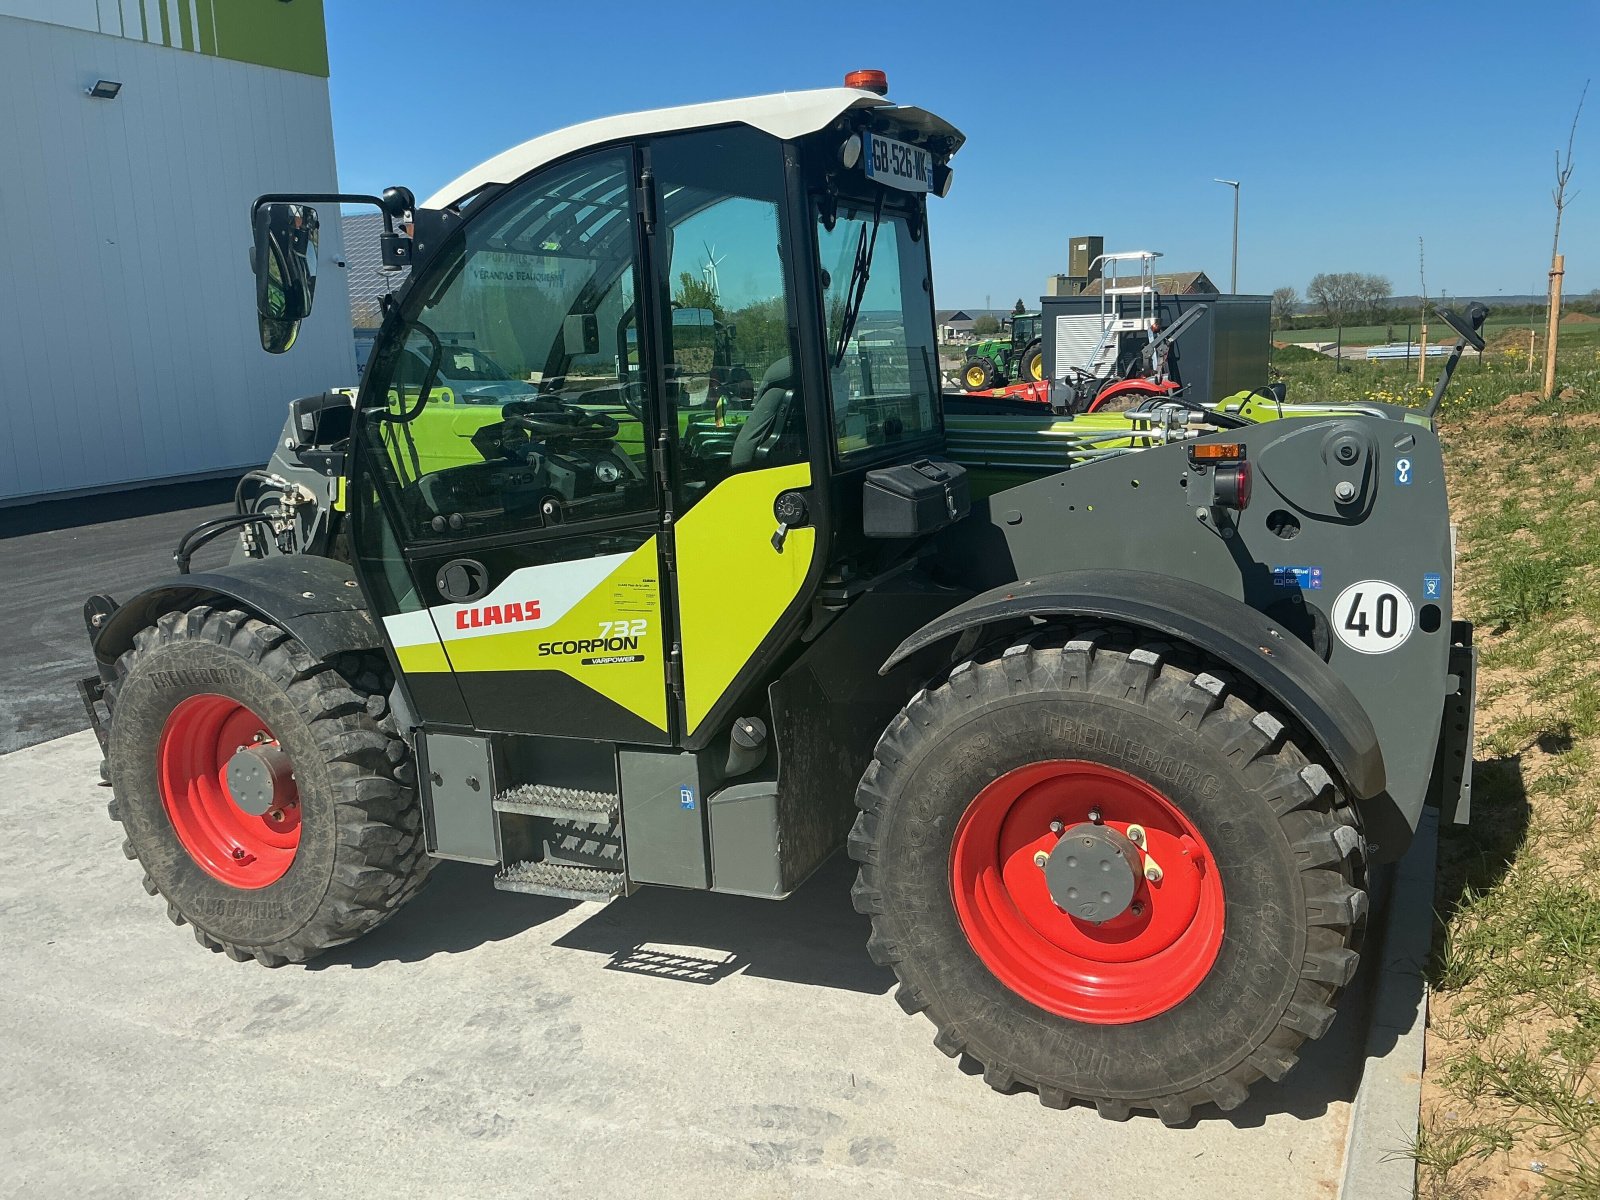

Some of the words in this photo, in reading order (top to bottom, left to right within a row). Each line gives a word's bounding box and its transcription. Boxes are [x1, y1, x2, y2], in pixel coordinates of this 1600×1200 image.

[456, 600, 541, 630] CLAAS
[1344, 592, 1399, 639] 40
[597, 618, 648, 640] 732
[538, 636, 638, 656] SCORPION
[592, 656, 635, 664] VARIPOWER
[148, 667, 241, 692] TRELLEBORG
[1040, 708, 1222, 800] TRELLEBORG
